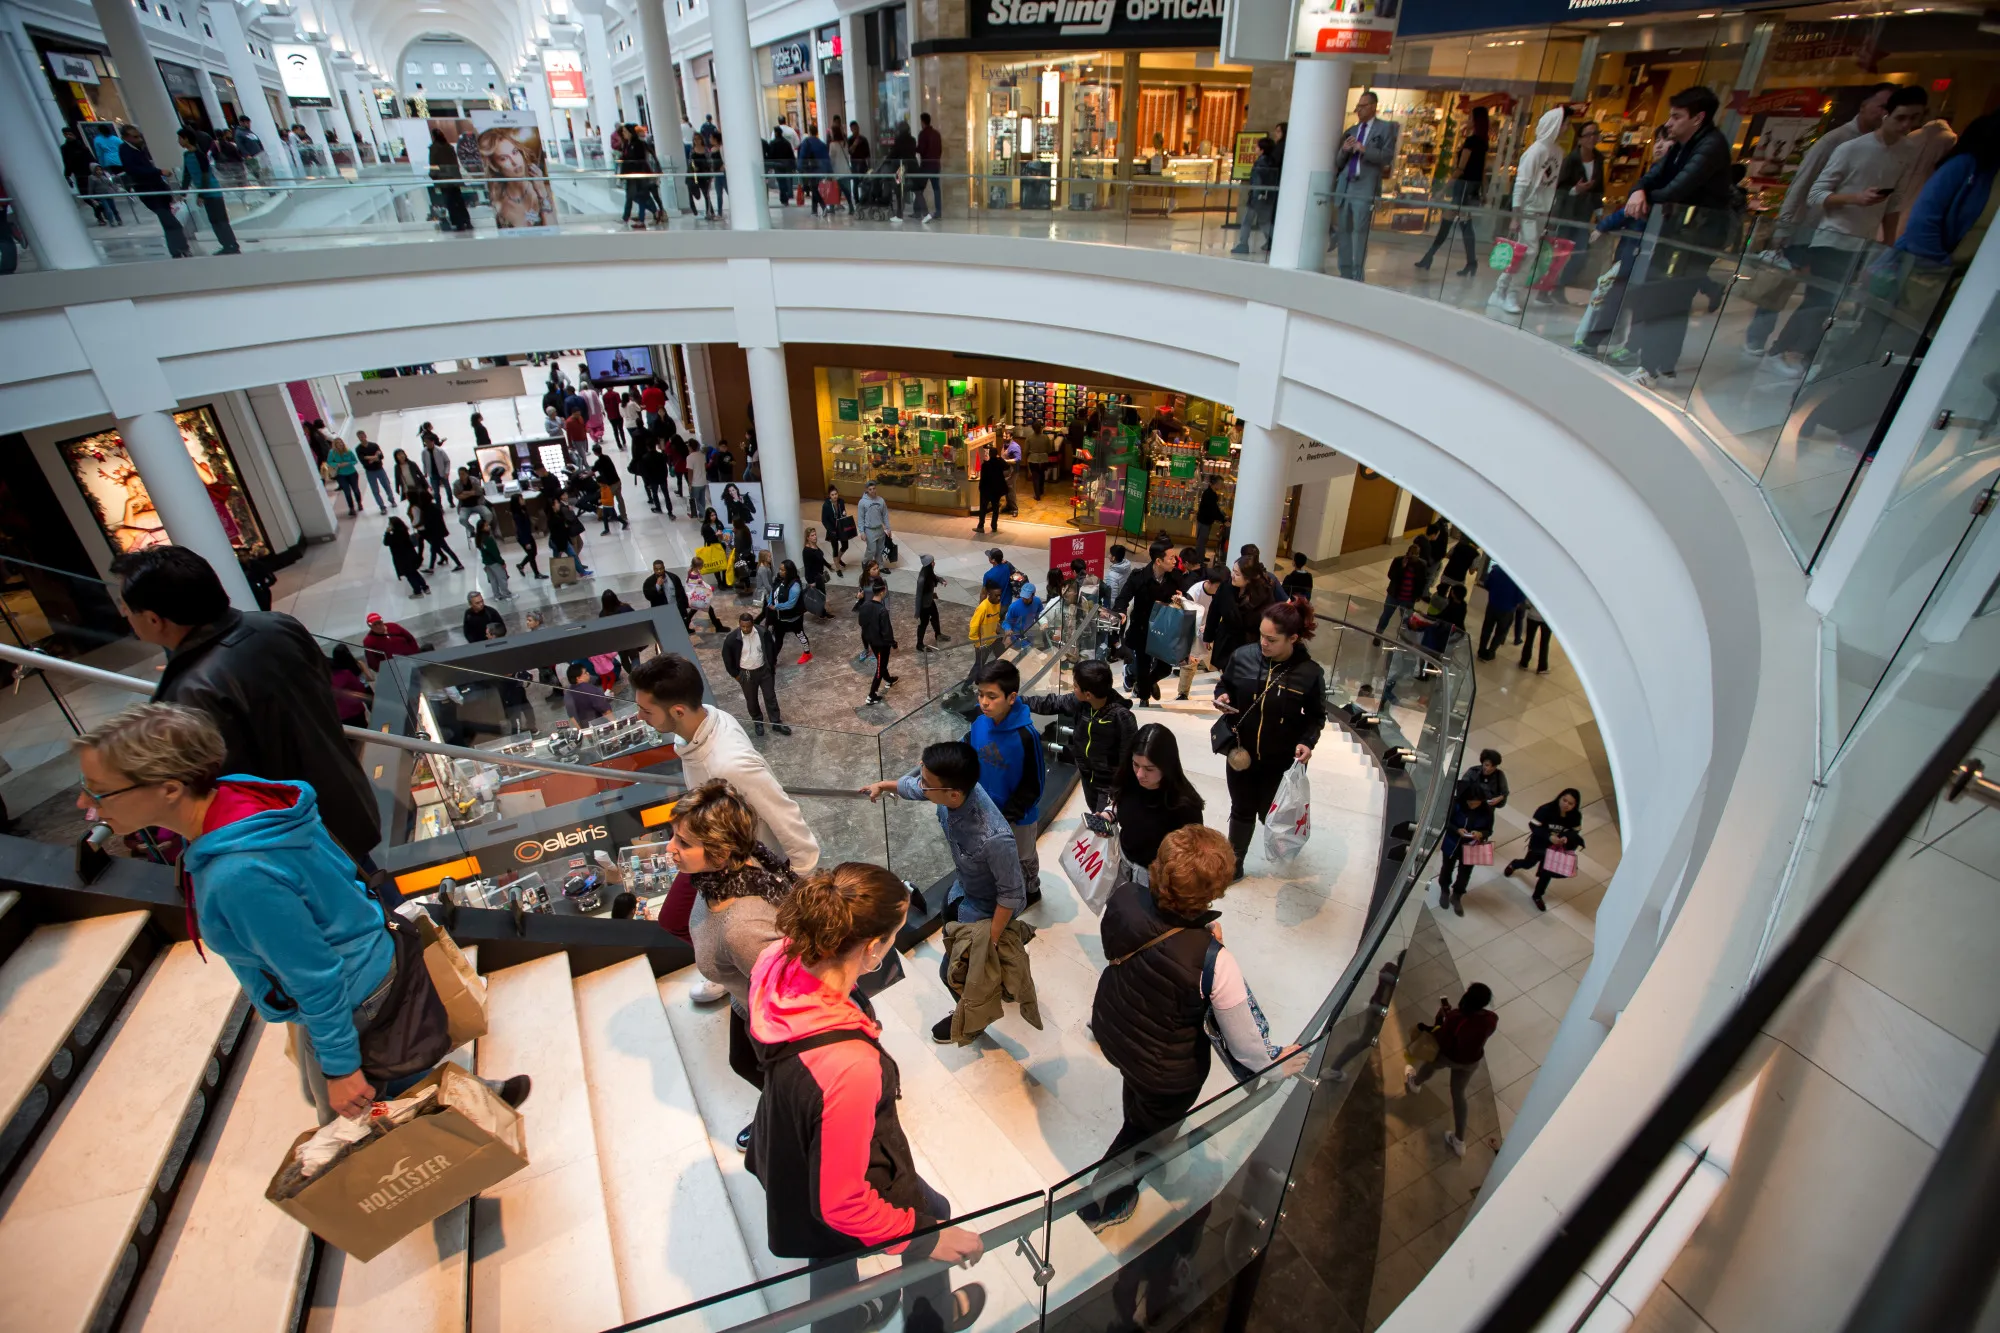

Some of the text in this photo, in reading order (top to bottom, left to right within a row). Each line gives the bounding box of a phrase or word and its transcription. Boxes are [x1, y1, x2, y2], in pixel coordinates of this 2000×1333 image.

[988, 0, 1116, 36] Sterling
[980, 63, 1029, 80] EyeMed
[456, 378, 489, 387] Restrooms
[1306, 451, 1337, 461] Restrooms
[1127, 487, 1143, 499] FREE!
[514, 824, 608, 863] Cellairis
[1072, 837, 1104, 881] H&M
[358, 1154, 453, 1214] HOLLISTER
